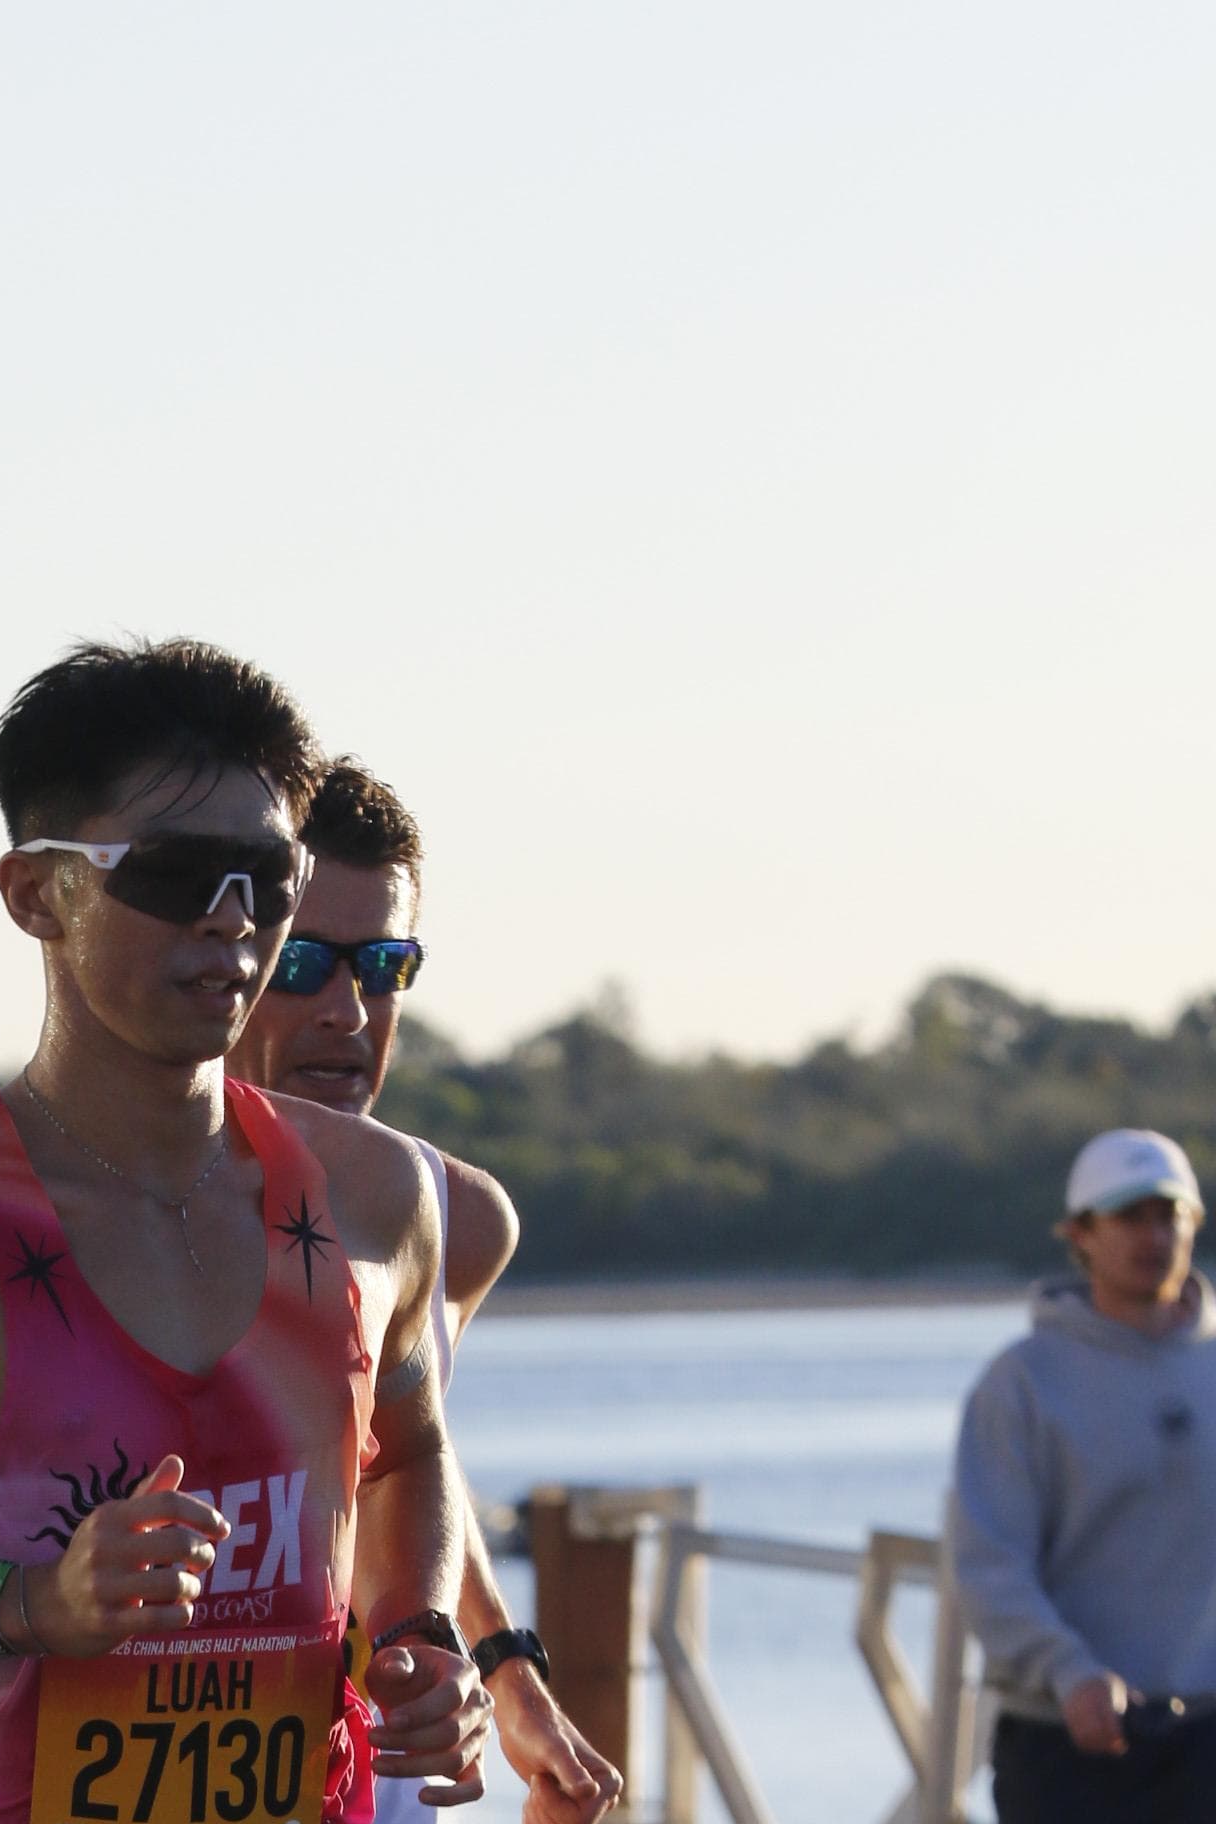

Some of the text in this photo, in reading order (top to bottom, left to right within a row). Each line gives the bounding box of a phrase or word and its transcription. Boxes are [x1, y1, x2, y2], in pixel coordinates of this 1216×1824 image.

[184, 1470, 308, 1595] EX
[214, 1591, 276, 1625] COAST
[134, 1641, 164, 1656] CHINA
[166, 1638, 212, 1655] AIRLINES
[213, 1637, 240, 1653] HALF
[241, 1635, 296, 1652] MARATHON
[147, 1661, 253, 1713] LUAH
[71, 1716, 305, 1822] 27130
